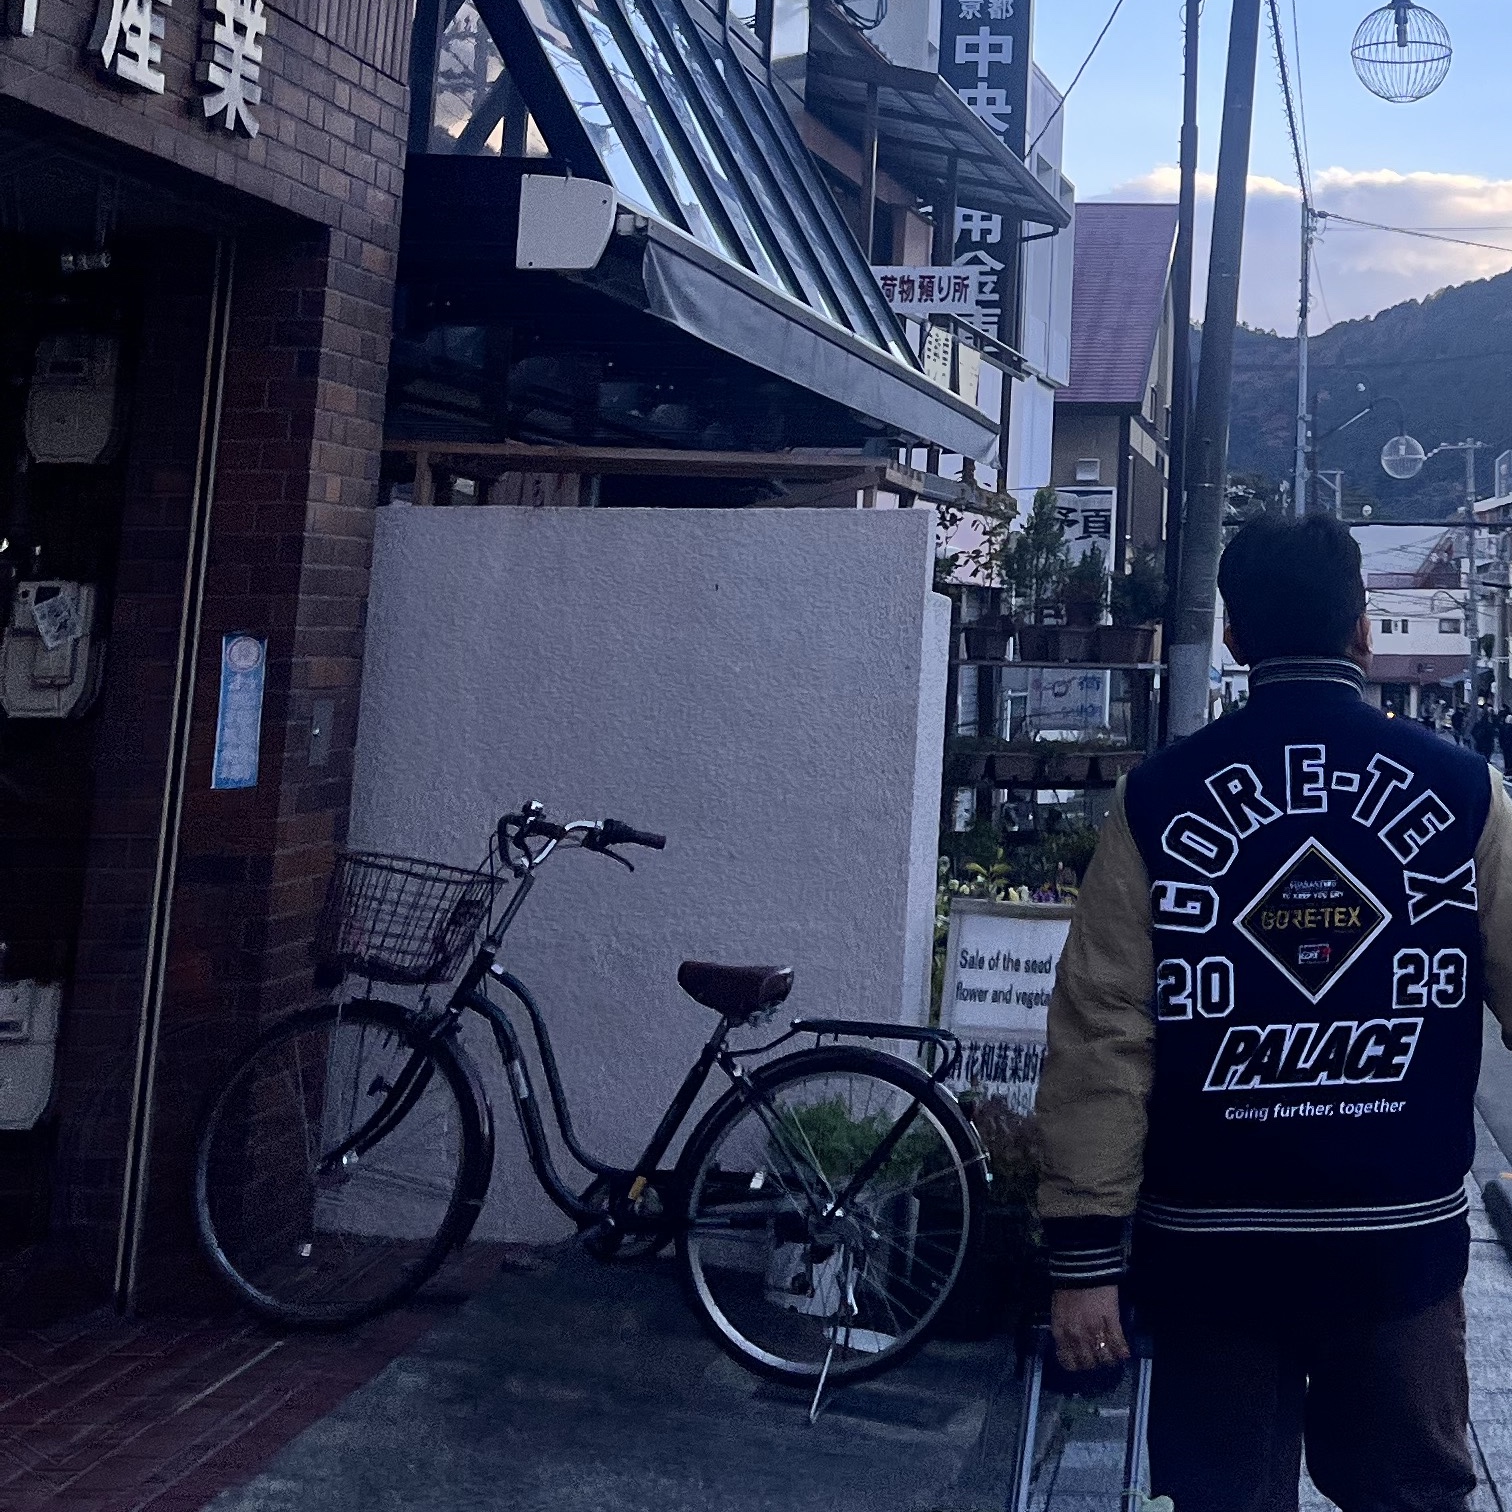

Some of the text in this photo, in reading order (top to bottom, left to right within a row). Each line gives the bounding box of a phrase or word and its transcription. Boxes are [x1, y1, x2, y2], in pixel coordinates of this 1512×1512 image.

[880, 274, 970, 304] 荷物預り所
[1152, 744, 1478, 935] GORE-TEX
[960, 949, 1053, 975] Sale of the seed
[956, 981, 989, 1003] flower
[991, 983, 1013, 1005] and
[1157, 948, 1468, 1021] 20 23
[1203, 1017, 1424, 1092] PALACE
[1225, 1099, 1406, 1122] Going further, together
